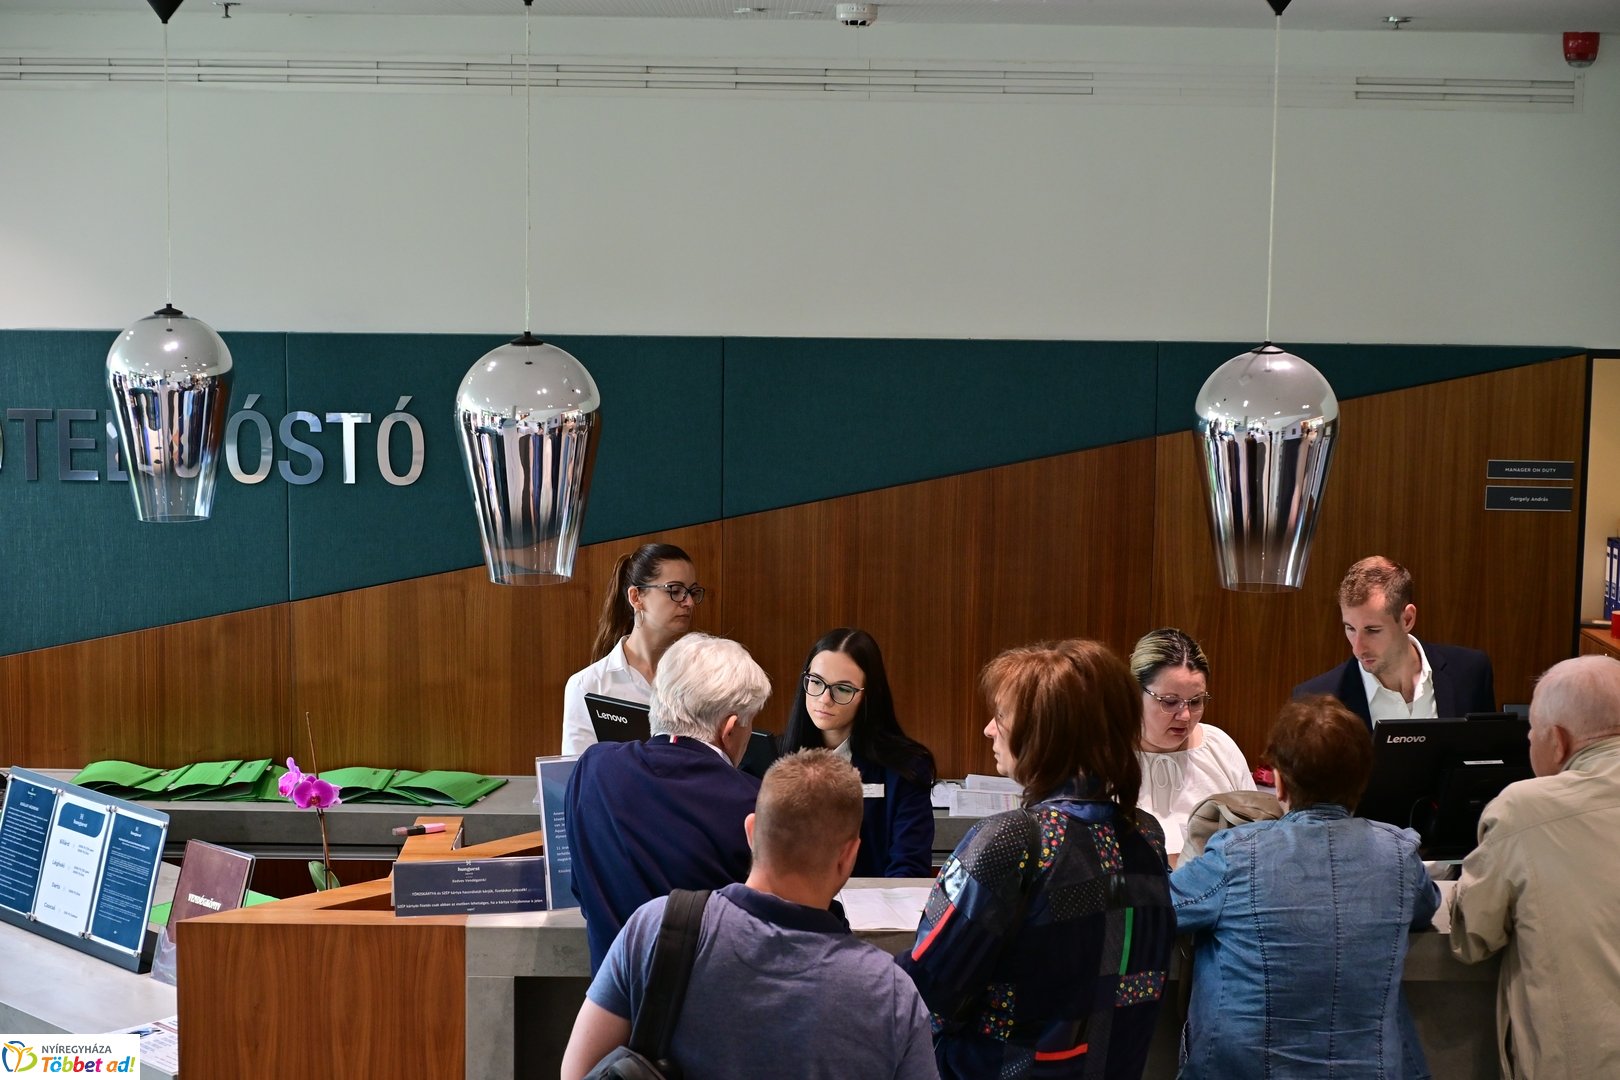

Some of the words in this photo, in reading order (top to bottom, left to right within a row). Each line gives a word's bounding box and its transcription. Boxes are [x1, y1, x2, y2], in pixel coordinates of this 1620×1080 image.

[0, 407, 129, 482] TEL
[224, 393, 426, 486] ÓSTÓ
[595, 709, 628, 724] Lenovo
[1386, 735, 1426, 744] Lenovo
